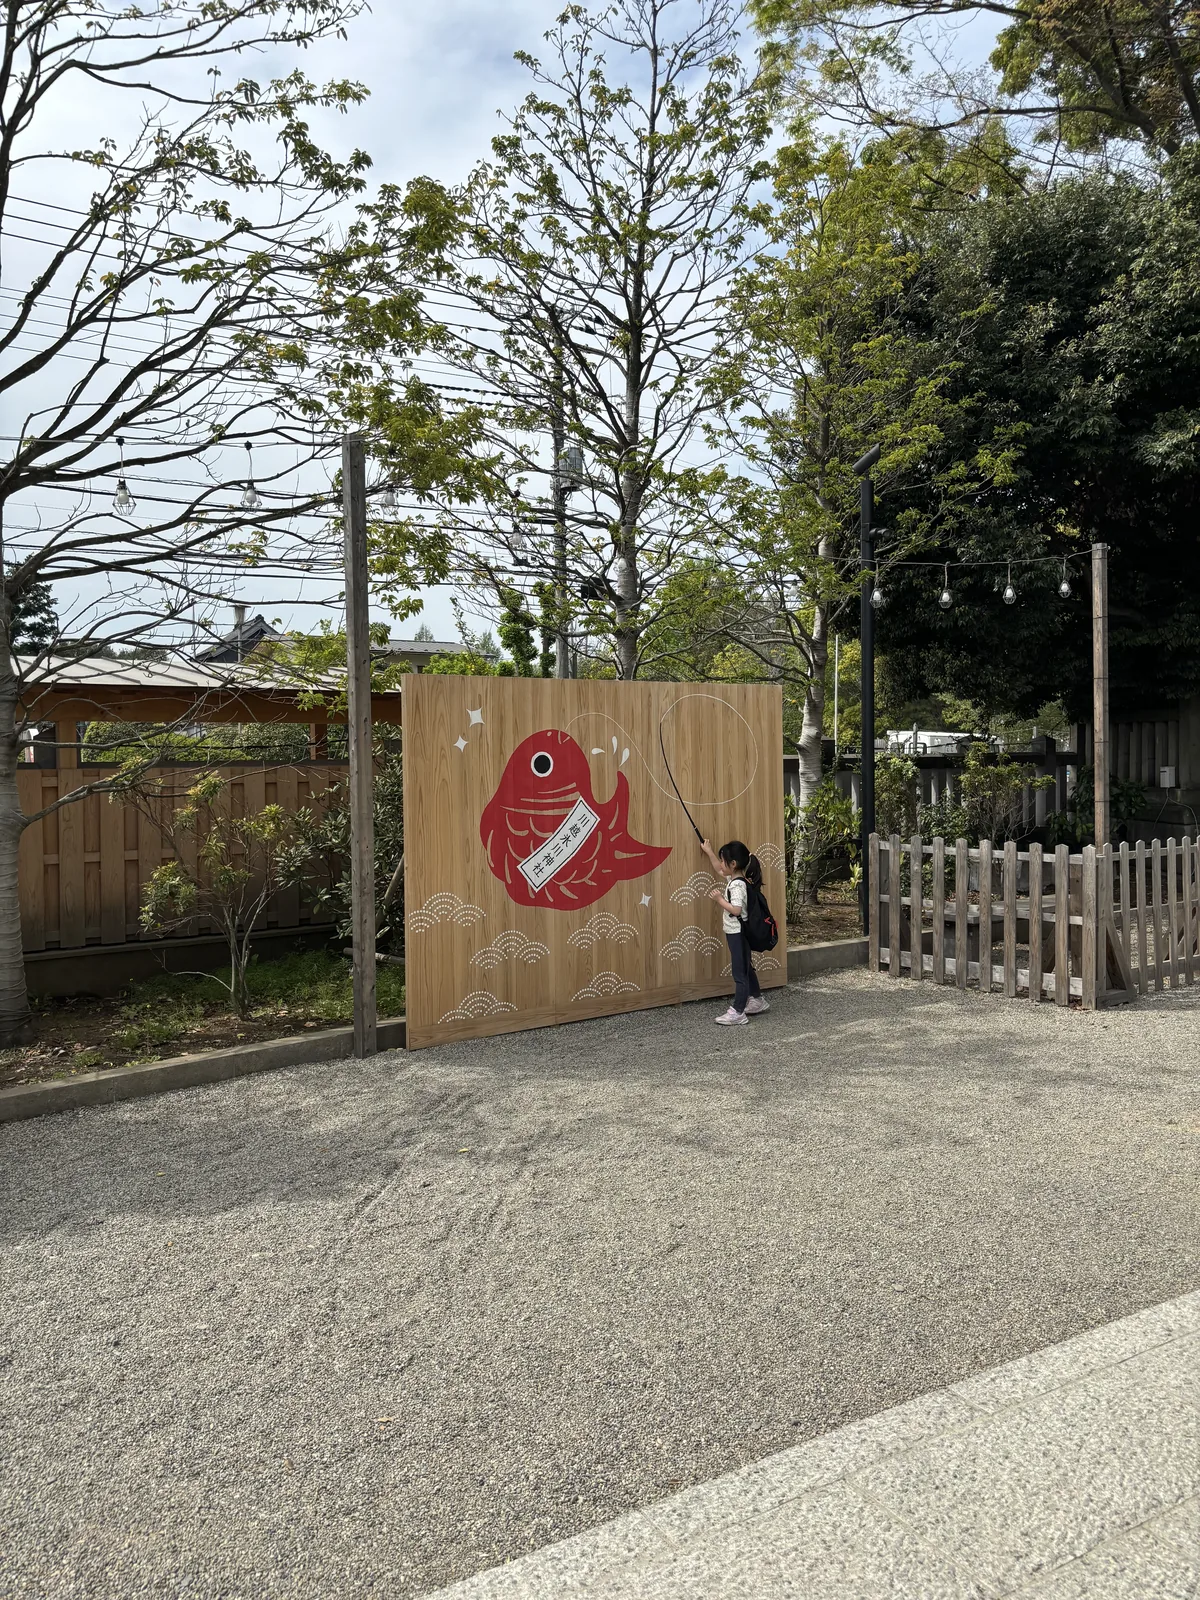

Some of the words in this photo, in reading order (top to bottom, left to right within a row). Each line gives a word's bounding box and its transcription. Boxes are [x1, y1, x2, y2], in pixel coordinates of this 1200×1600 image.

[532, 813, 590, 878] 川越氷川神社
